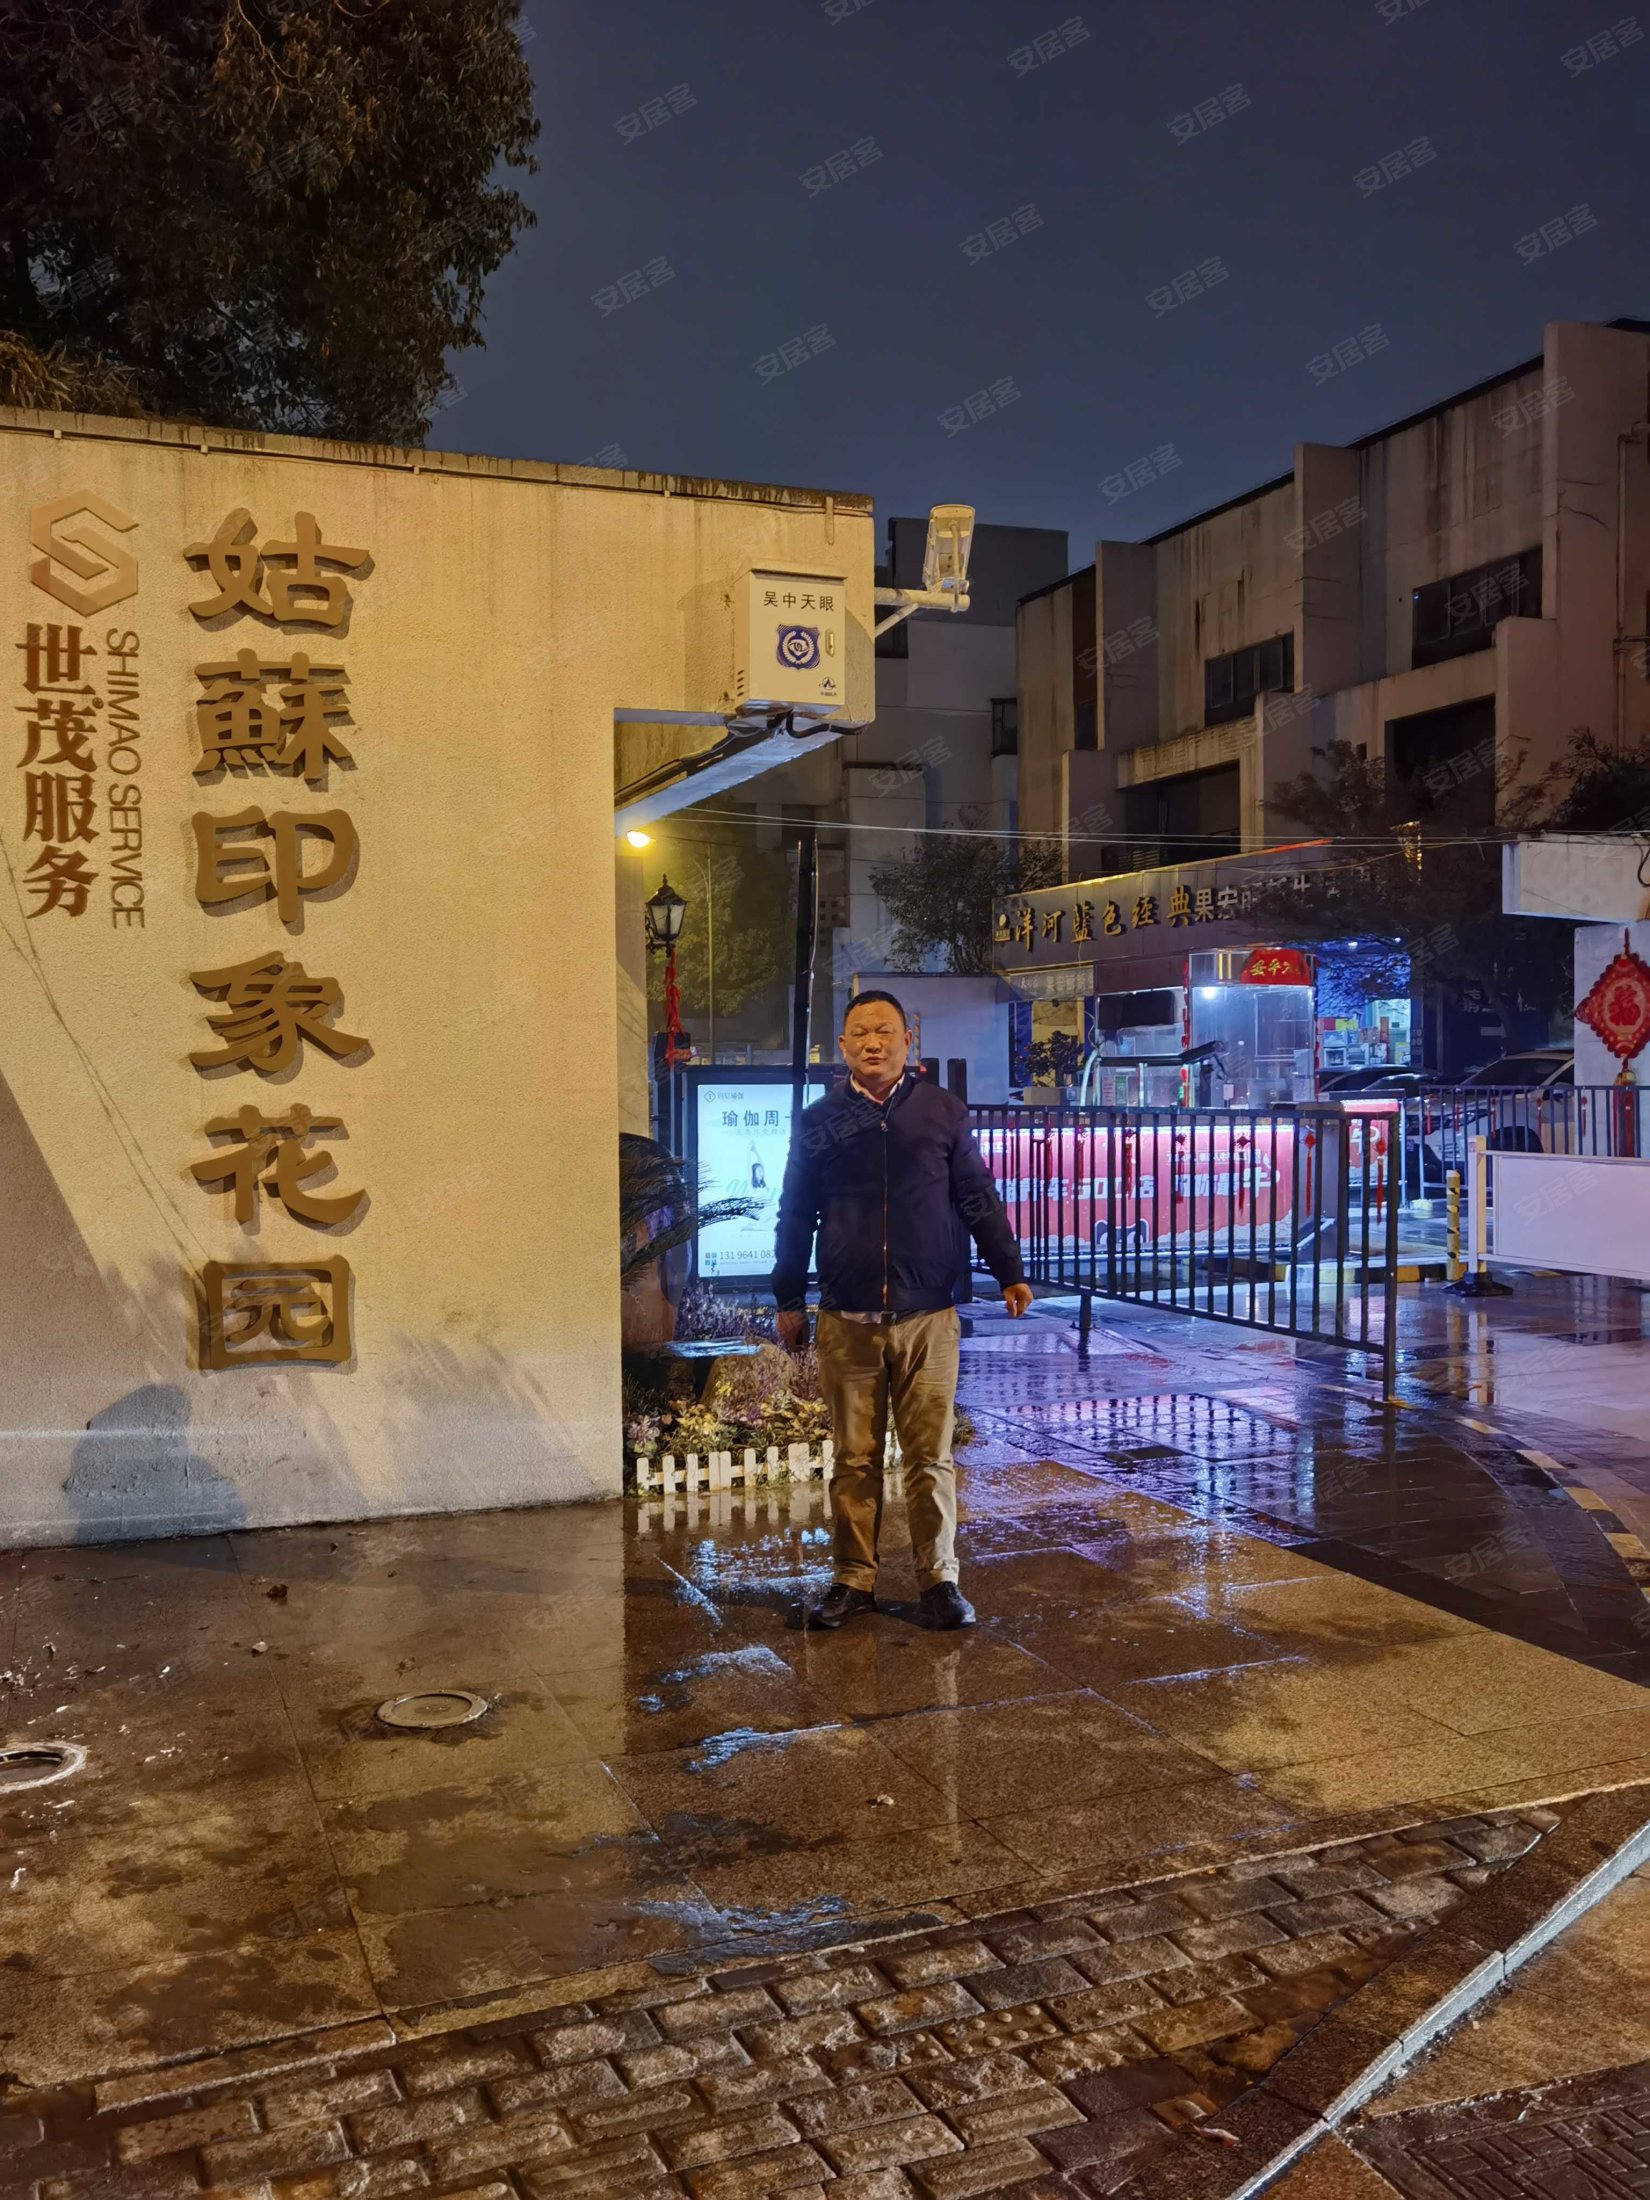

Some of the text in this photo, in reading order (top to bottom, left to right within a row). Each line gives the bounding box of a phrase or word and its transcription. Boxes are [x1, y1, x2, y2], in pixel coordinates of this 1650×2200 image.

[763, 590, 835, 612] 吴中天眼
[14, 622, 99, 919] 世茂服务
[106, 628, 145, 929] SHIMAO SERVICE
[720, 1251, 735, 1260] 131
[737, 1250, 758, 1260] 9641
